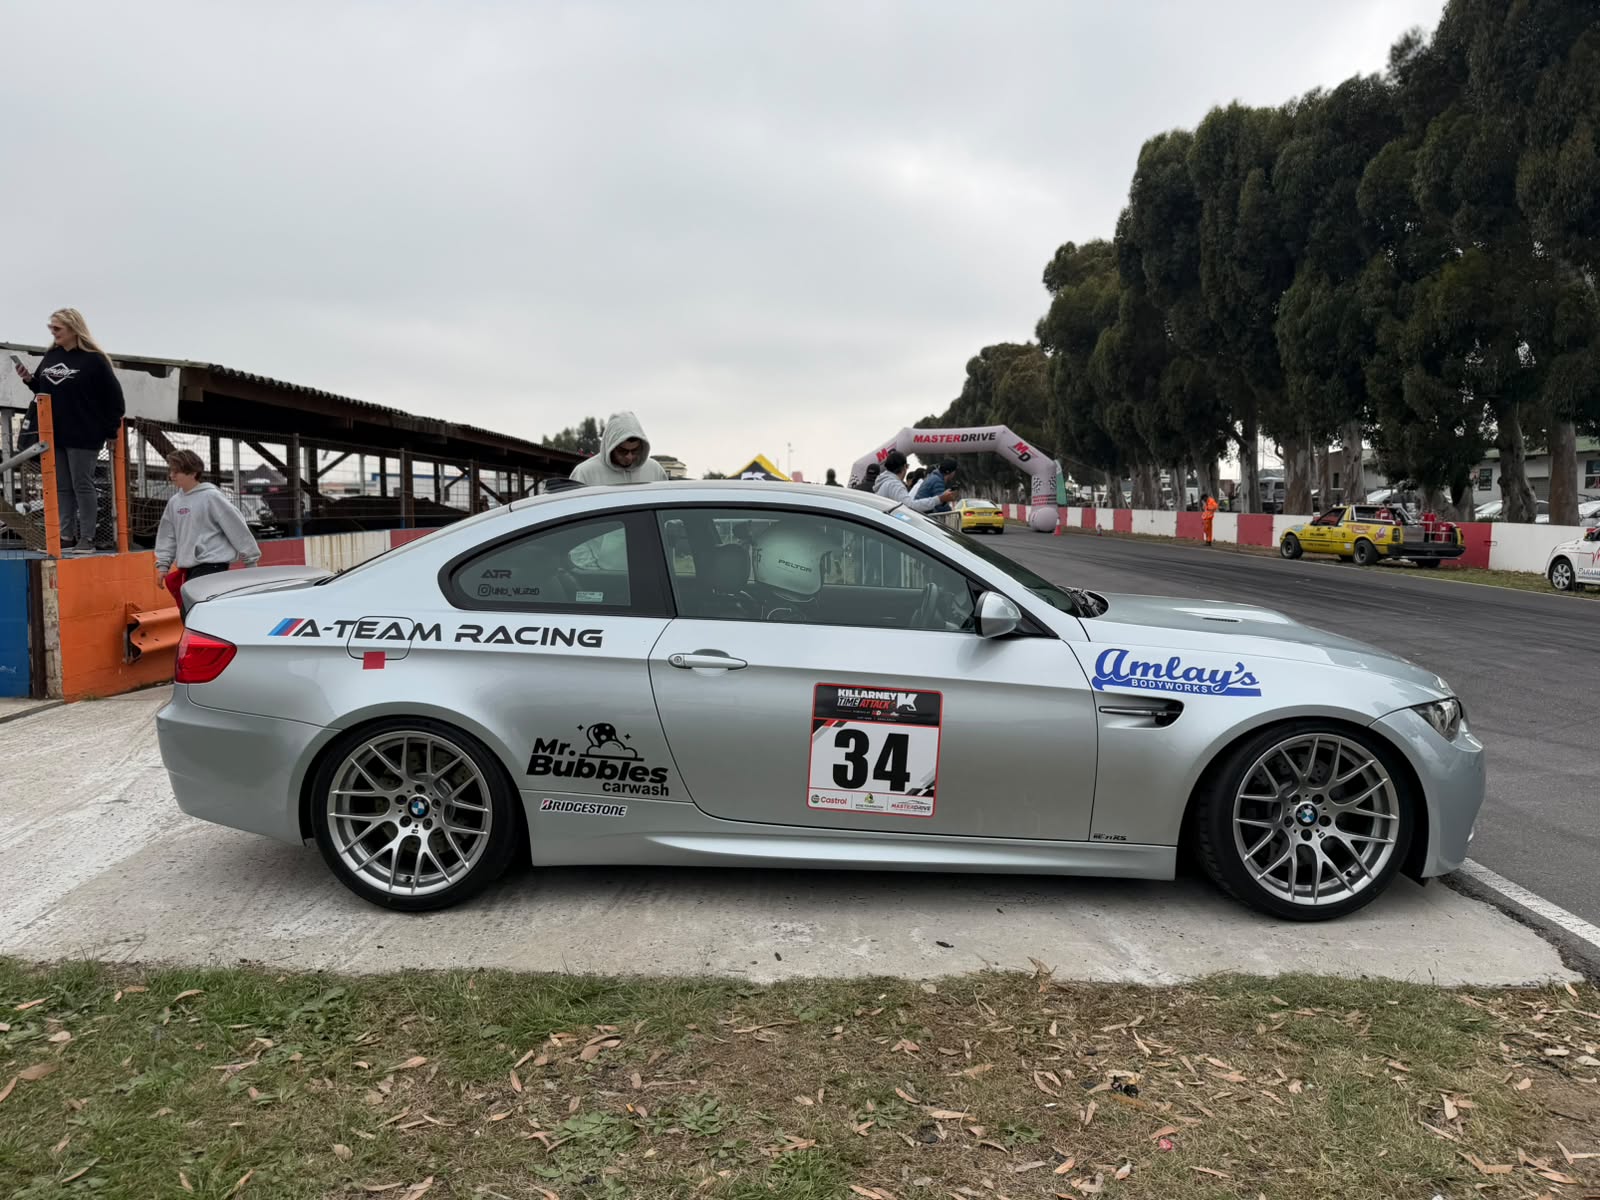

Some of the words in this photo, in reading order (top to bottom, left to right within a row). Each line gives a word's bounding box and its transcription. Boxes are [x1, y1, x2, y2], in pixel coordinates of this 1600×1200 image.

[913, 432, 997, 443] MASTERDRIVE
[481, 569, 512, 579] ATR
[293, 618, 442, 642] A-TEAM
[455, 623, 604, 648] RACING
[1095, 648, 1259, 693] Amlay's
[1131, 679, 1208, 693] BODYWORKS
[837, 688, 897, 700] KILLARNEY
[836, 697, 860, 707] TIME
[860, 699, 891, 710] ATTACK
[532, 737, 576, 757] Mr.
[833, 728, 911, 792] 34
[526, 754, 669, 784] Bubbles
[602, 781, 669, 796] carwash
[820, 796, 848, 805] Castrol
[891, 803, 931, 812] MASTERDRIVE
[541, 800, 627, 817] BRIDGESTONE
